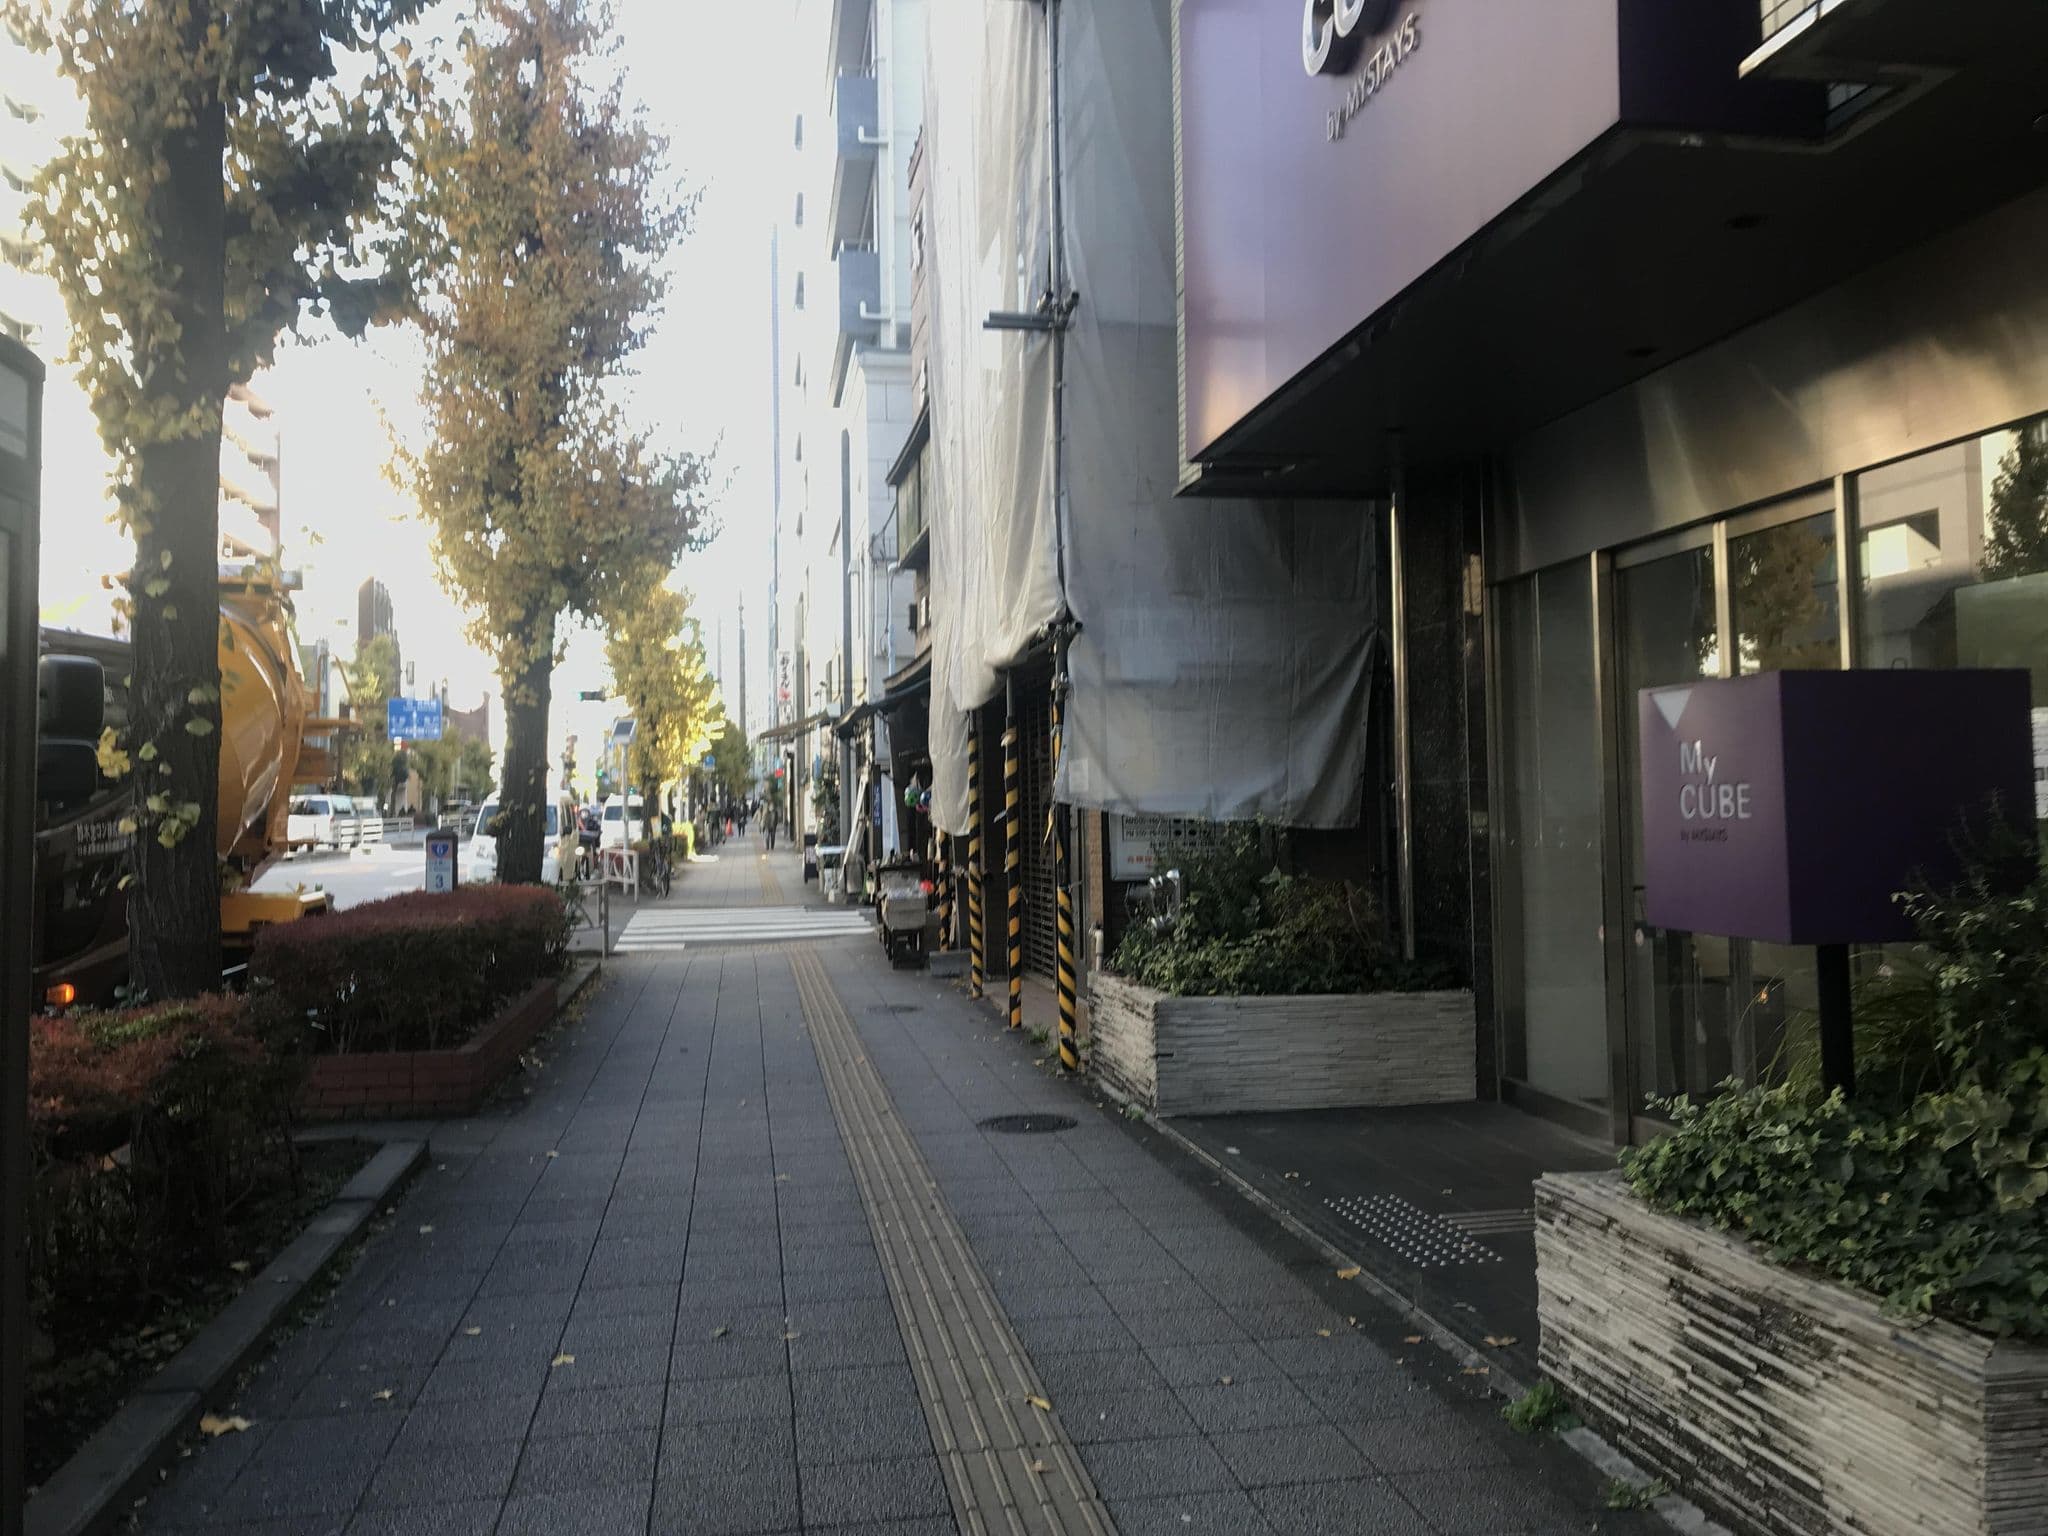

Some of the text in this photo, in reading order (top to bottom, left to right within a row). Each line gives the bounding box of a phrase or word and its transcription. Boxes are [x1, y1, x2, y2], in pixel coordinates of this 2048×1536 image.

[1345, 12, 1415, 121] MYSTAYS
[1680, 739, 1717, 784] My
[1680, 784, 1752, 819] CUBE
[435, 874, 444, 889] 3
